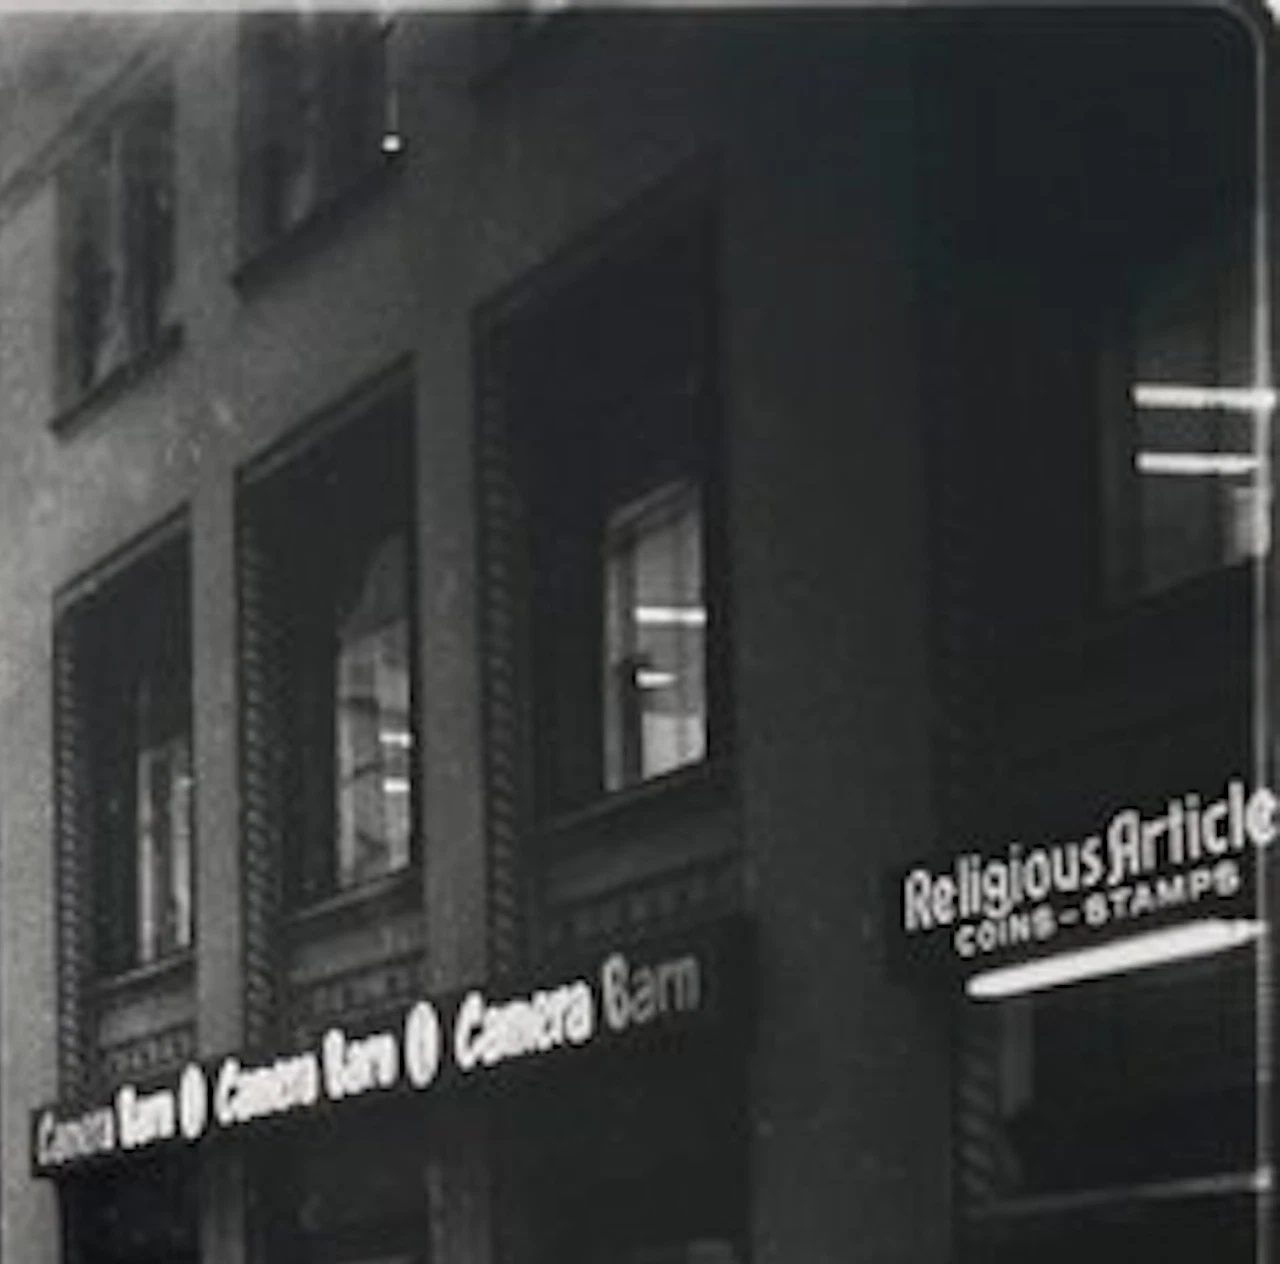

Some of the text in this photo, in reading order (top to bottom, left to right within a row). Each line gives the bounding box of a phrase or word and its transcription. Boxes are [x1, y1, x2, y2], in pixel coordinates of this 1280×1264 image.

[904, 841, 1104, 931] Religious
[453, 990, 593, 1071] Camera
[601, 952, 699, 1031] Barn
